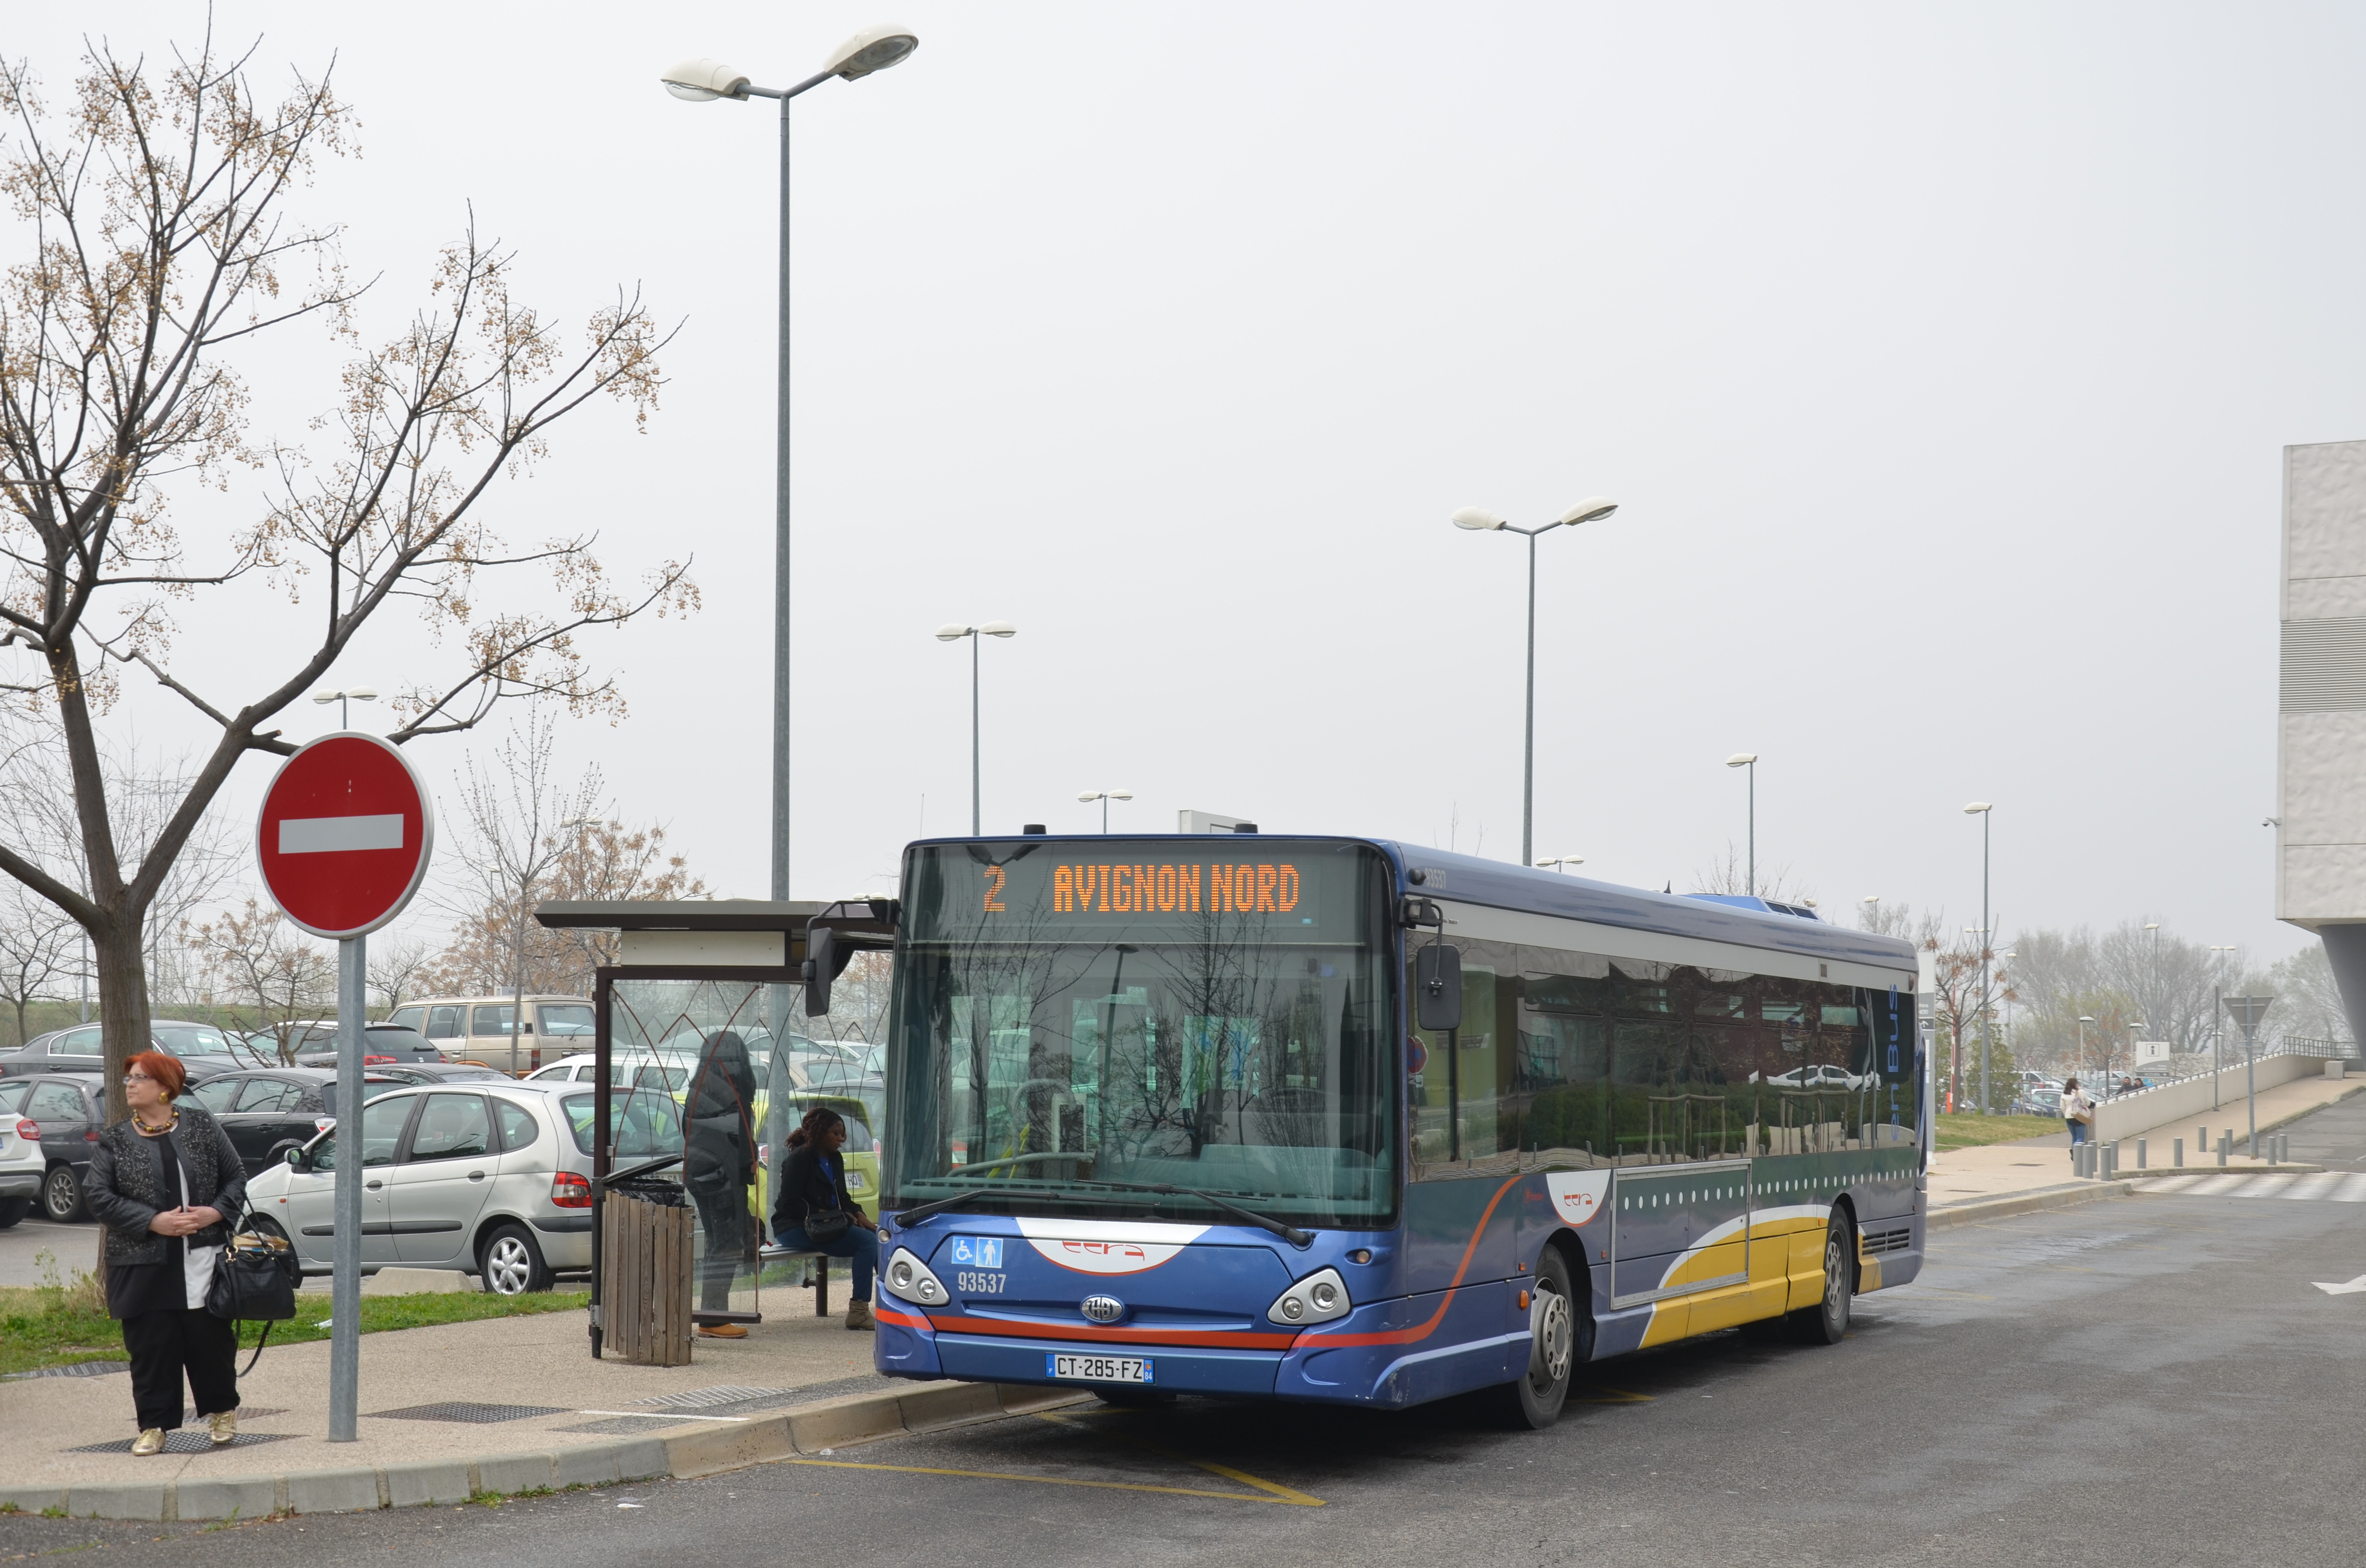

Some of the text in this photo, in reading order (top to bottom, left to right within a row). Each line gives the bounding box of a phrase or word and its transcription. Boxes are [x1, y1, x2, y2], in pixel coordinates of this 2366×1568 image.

[984, 865, 1299, 912] 2 AVIGNON NORD
[958, 1272, 1007, 1293] 93537
[1057, 1357, 1142, 1379] CT-285-FZ
[1145, 1371, 1153, 1380] 84
